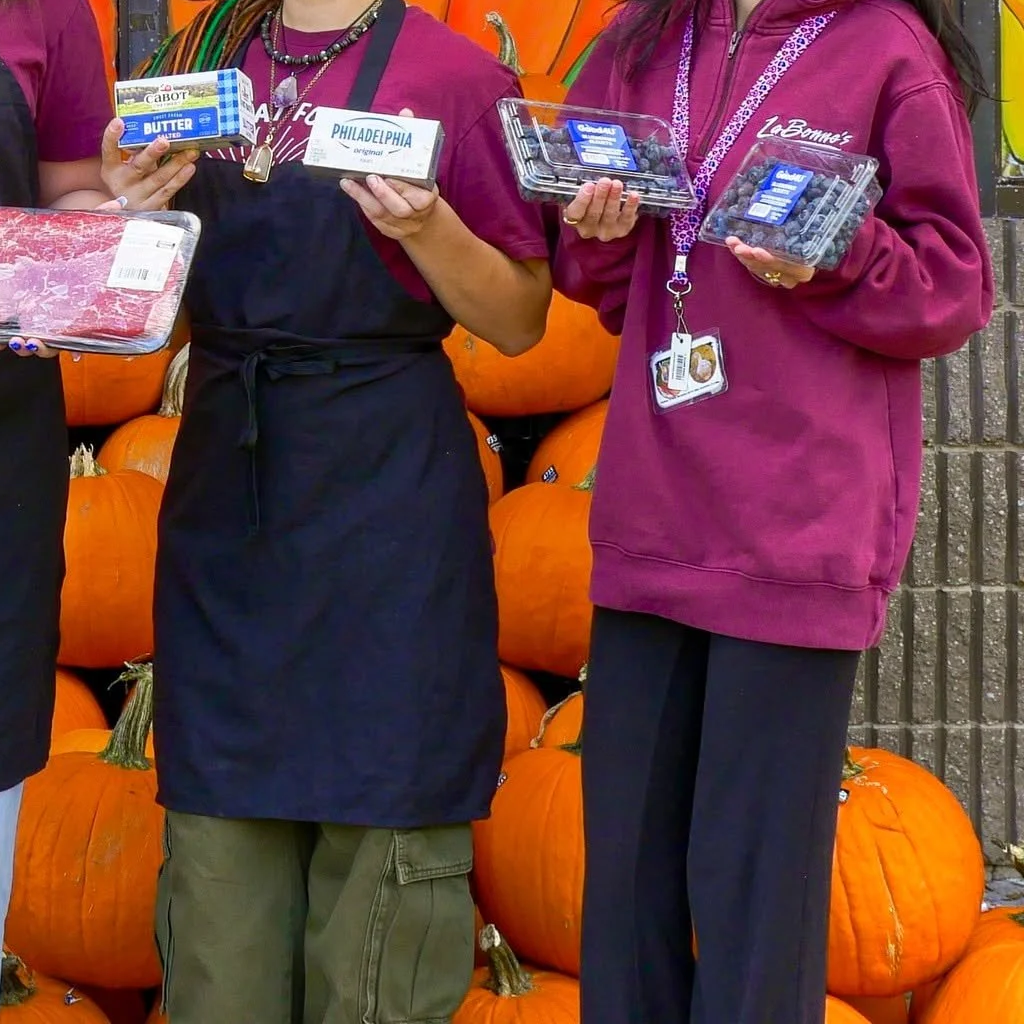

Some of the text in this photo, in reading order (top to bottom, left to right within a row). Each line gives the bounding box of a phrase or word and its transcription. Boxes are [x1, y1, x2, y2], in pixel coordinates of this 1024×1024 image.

[143, 118, 193, 135] BUTTER
[331, 123, 413, 149] PHILADELPHIA
[353, 147, 384, 156] original
